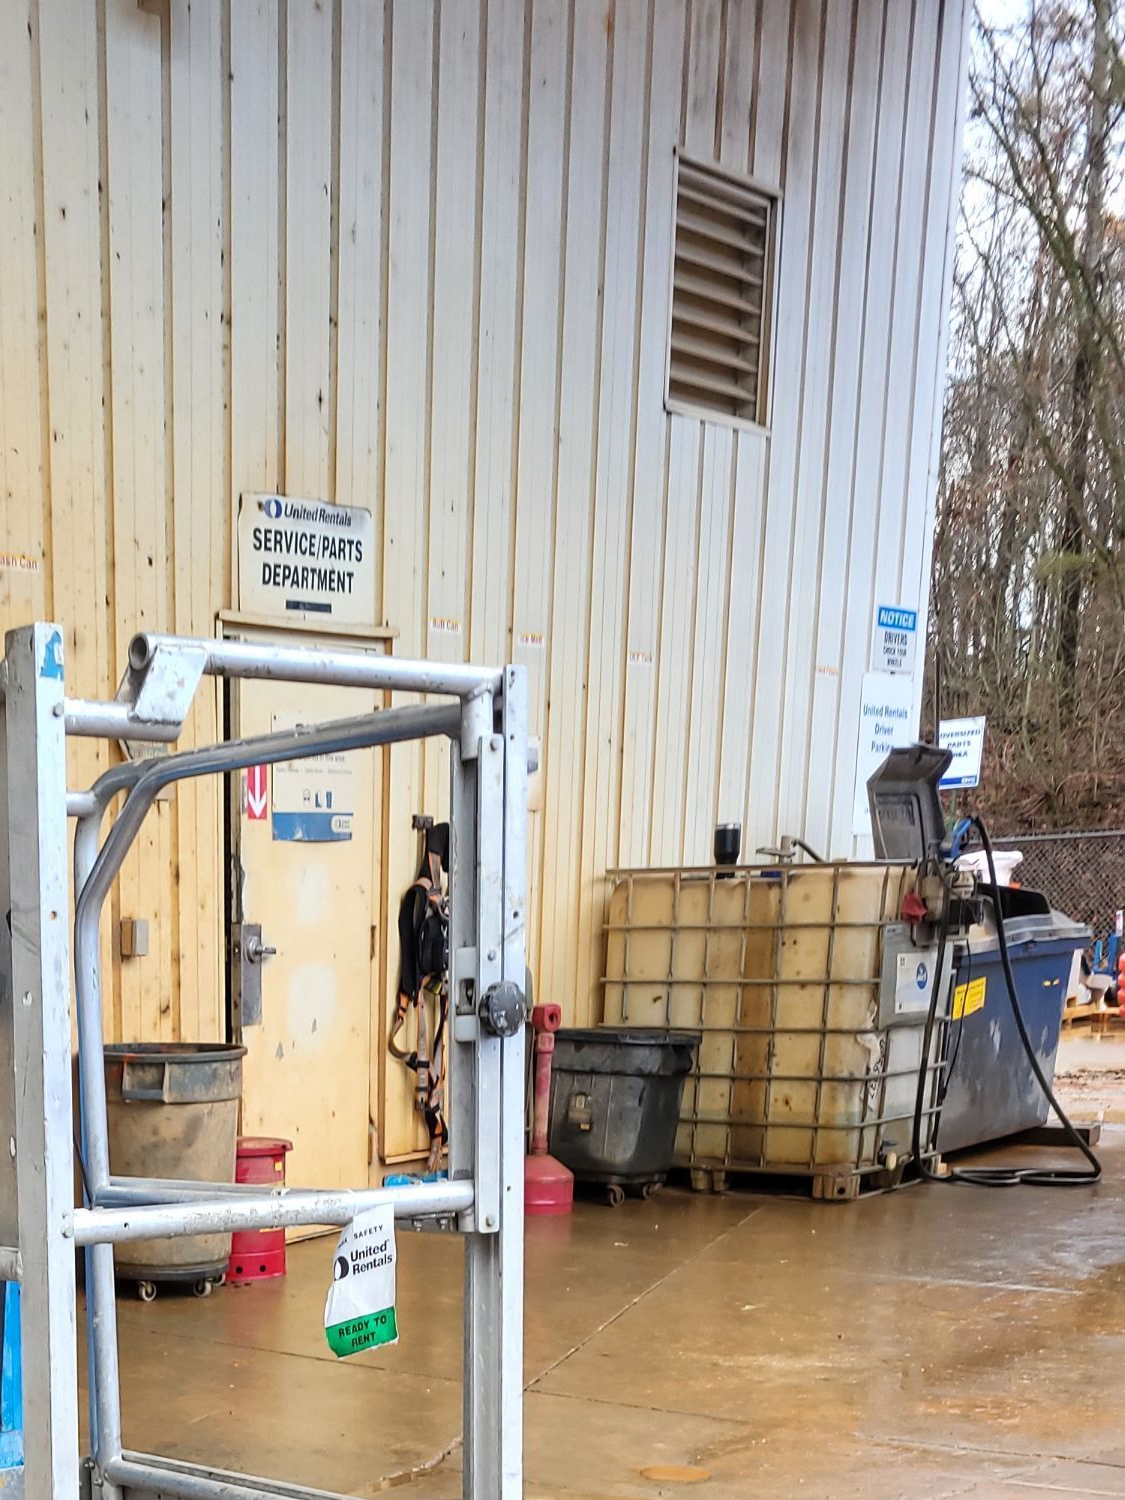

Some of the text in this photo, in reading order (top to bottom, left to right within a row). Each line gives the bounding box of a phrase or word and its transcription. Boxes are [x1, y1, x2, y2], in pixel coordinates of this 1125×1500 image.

[284, 502, 352, 527] United Rentals
[252, 527, 363, 563] SERVICE/PARTS
[19, 554, 39, 570] Can
[262, 562, 354, 594] DEPARTMENT
[879, 608, 915, 630] NOTICE
[884, 630, 908, 647] DRIVERS
[863, 703, 908, 719] United Rentals
[875, 722, 894, 736] Driver
[353, 1224, 383, 1240] SAFETY
[350, 1239, 388, 1262] United
[352, 1253, 393, 1276] Rentals
[338, 1315, 387, 1339] READY TO
[351, 1331, 376, 1348] RENT
